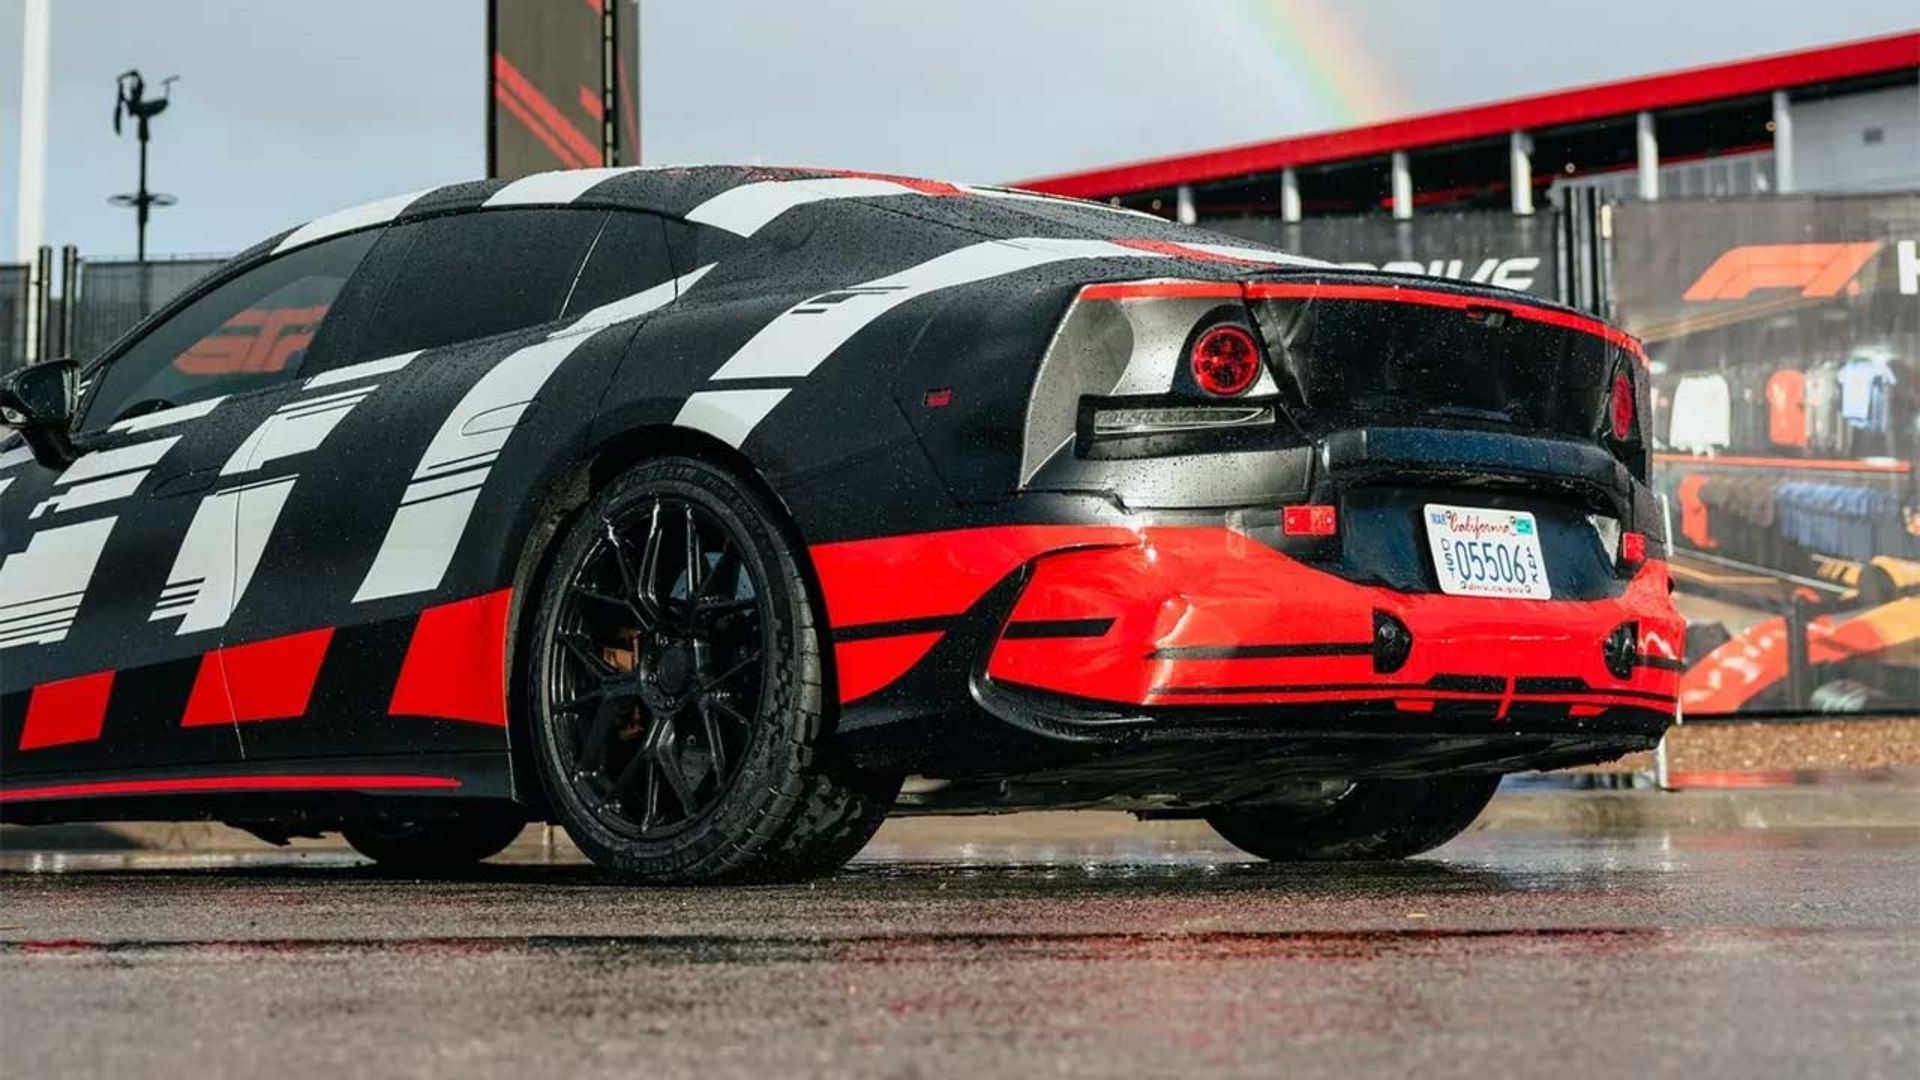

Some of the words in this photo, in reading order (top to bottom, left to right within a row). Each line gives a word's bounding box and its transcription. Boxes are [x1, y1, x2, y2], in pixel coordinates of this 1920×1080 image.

[1340, 258, 1541, 291] IVE
[1682, 240, 1881, 300] F1
[1449, 512, 1511, 539] California
[1454, 540, 1526, 584] 05506
